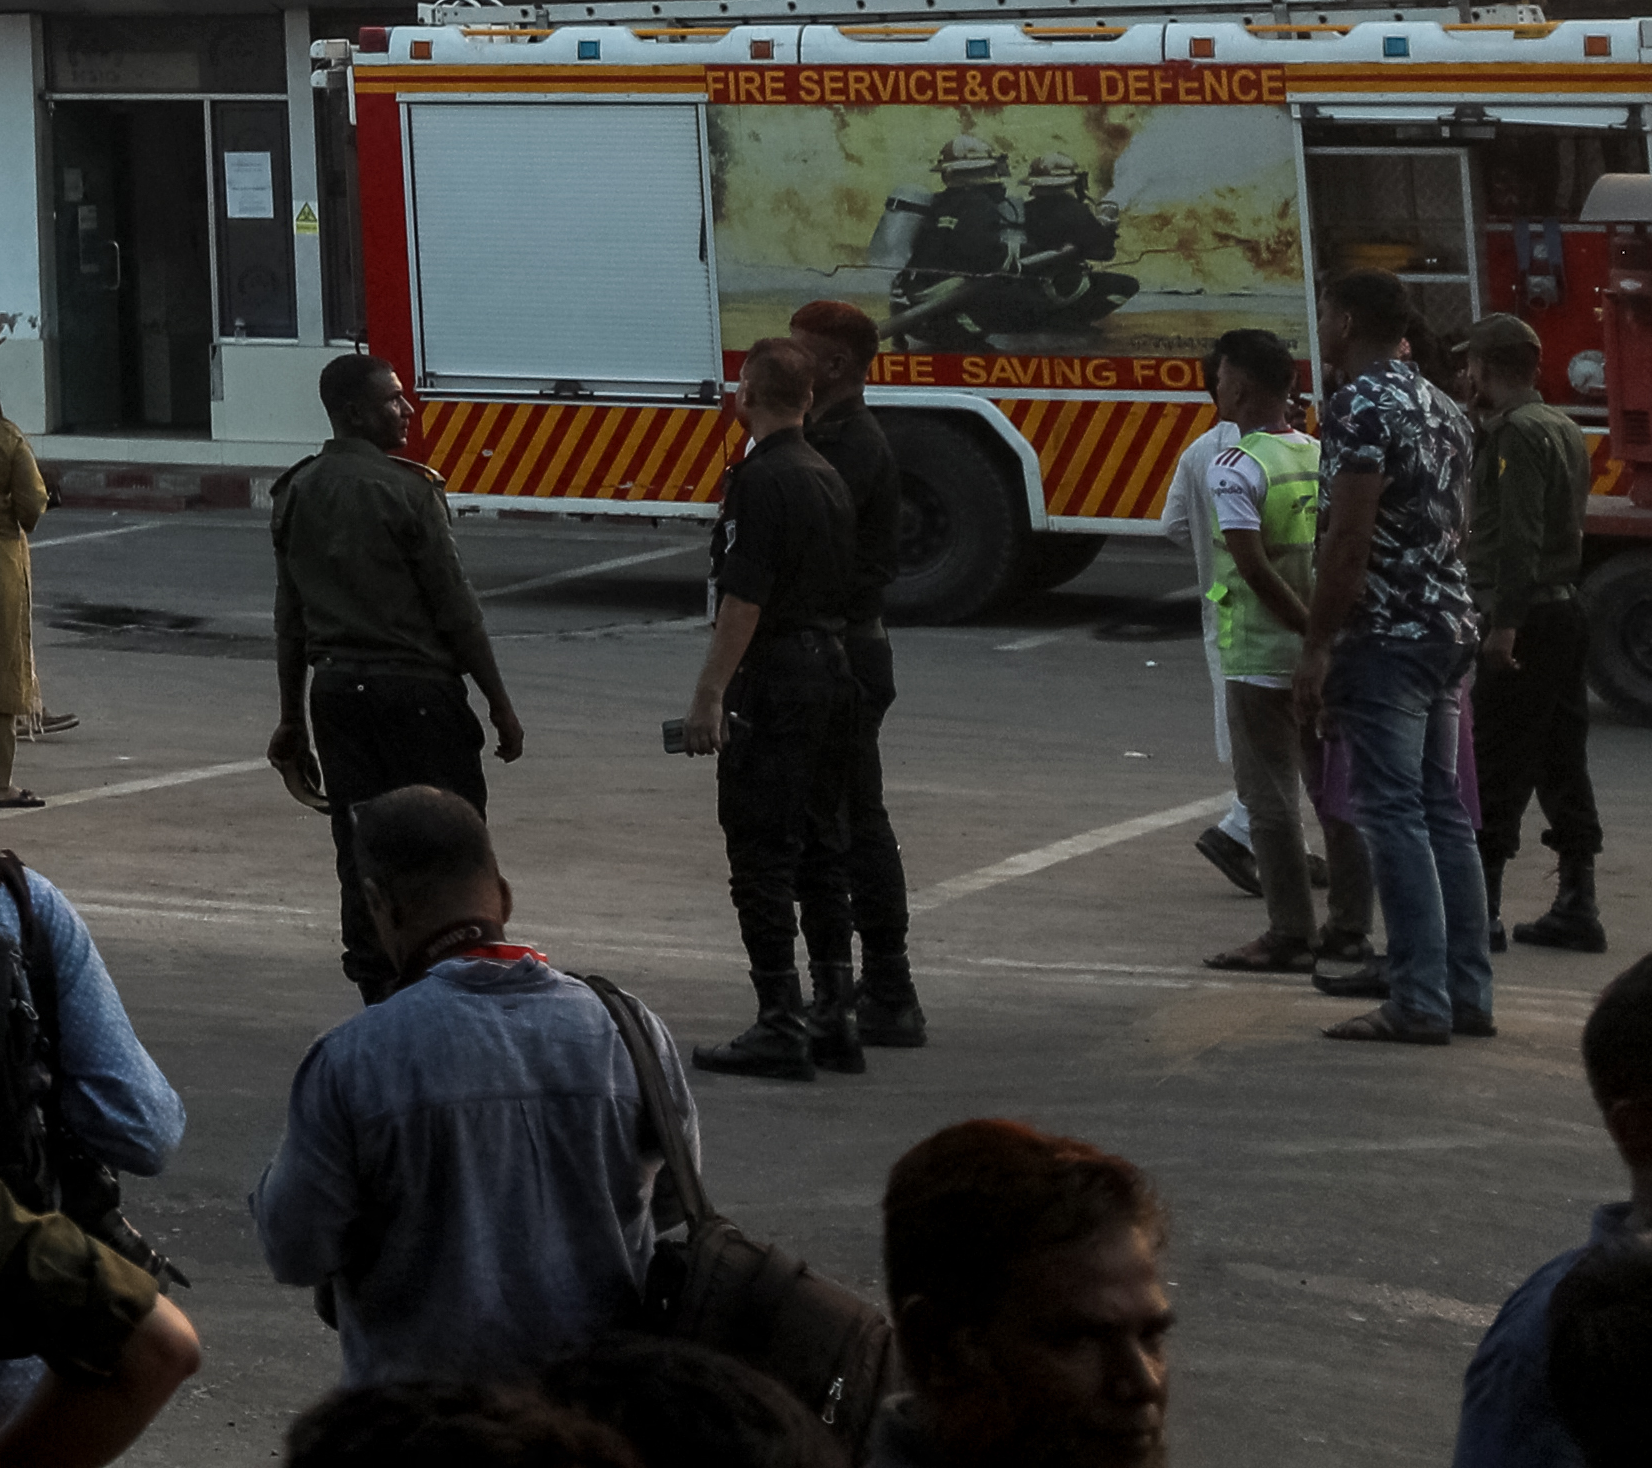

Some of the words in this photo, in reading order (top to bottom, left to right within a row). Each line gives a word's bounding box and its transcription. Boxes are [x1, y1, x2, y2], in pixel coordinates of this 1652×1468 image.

[705, 69, 787, 102] FIRE
[1099, 67, 1285, 102] DEFENCE
[869, 354, 935, 384] IFE
[961, 356, 1118, 387] SAVING
